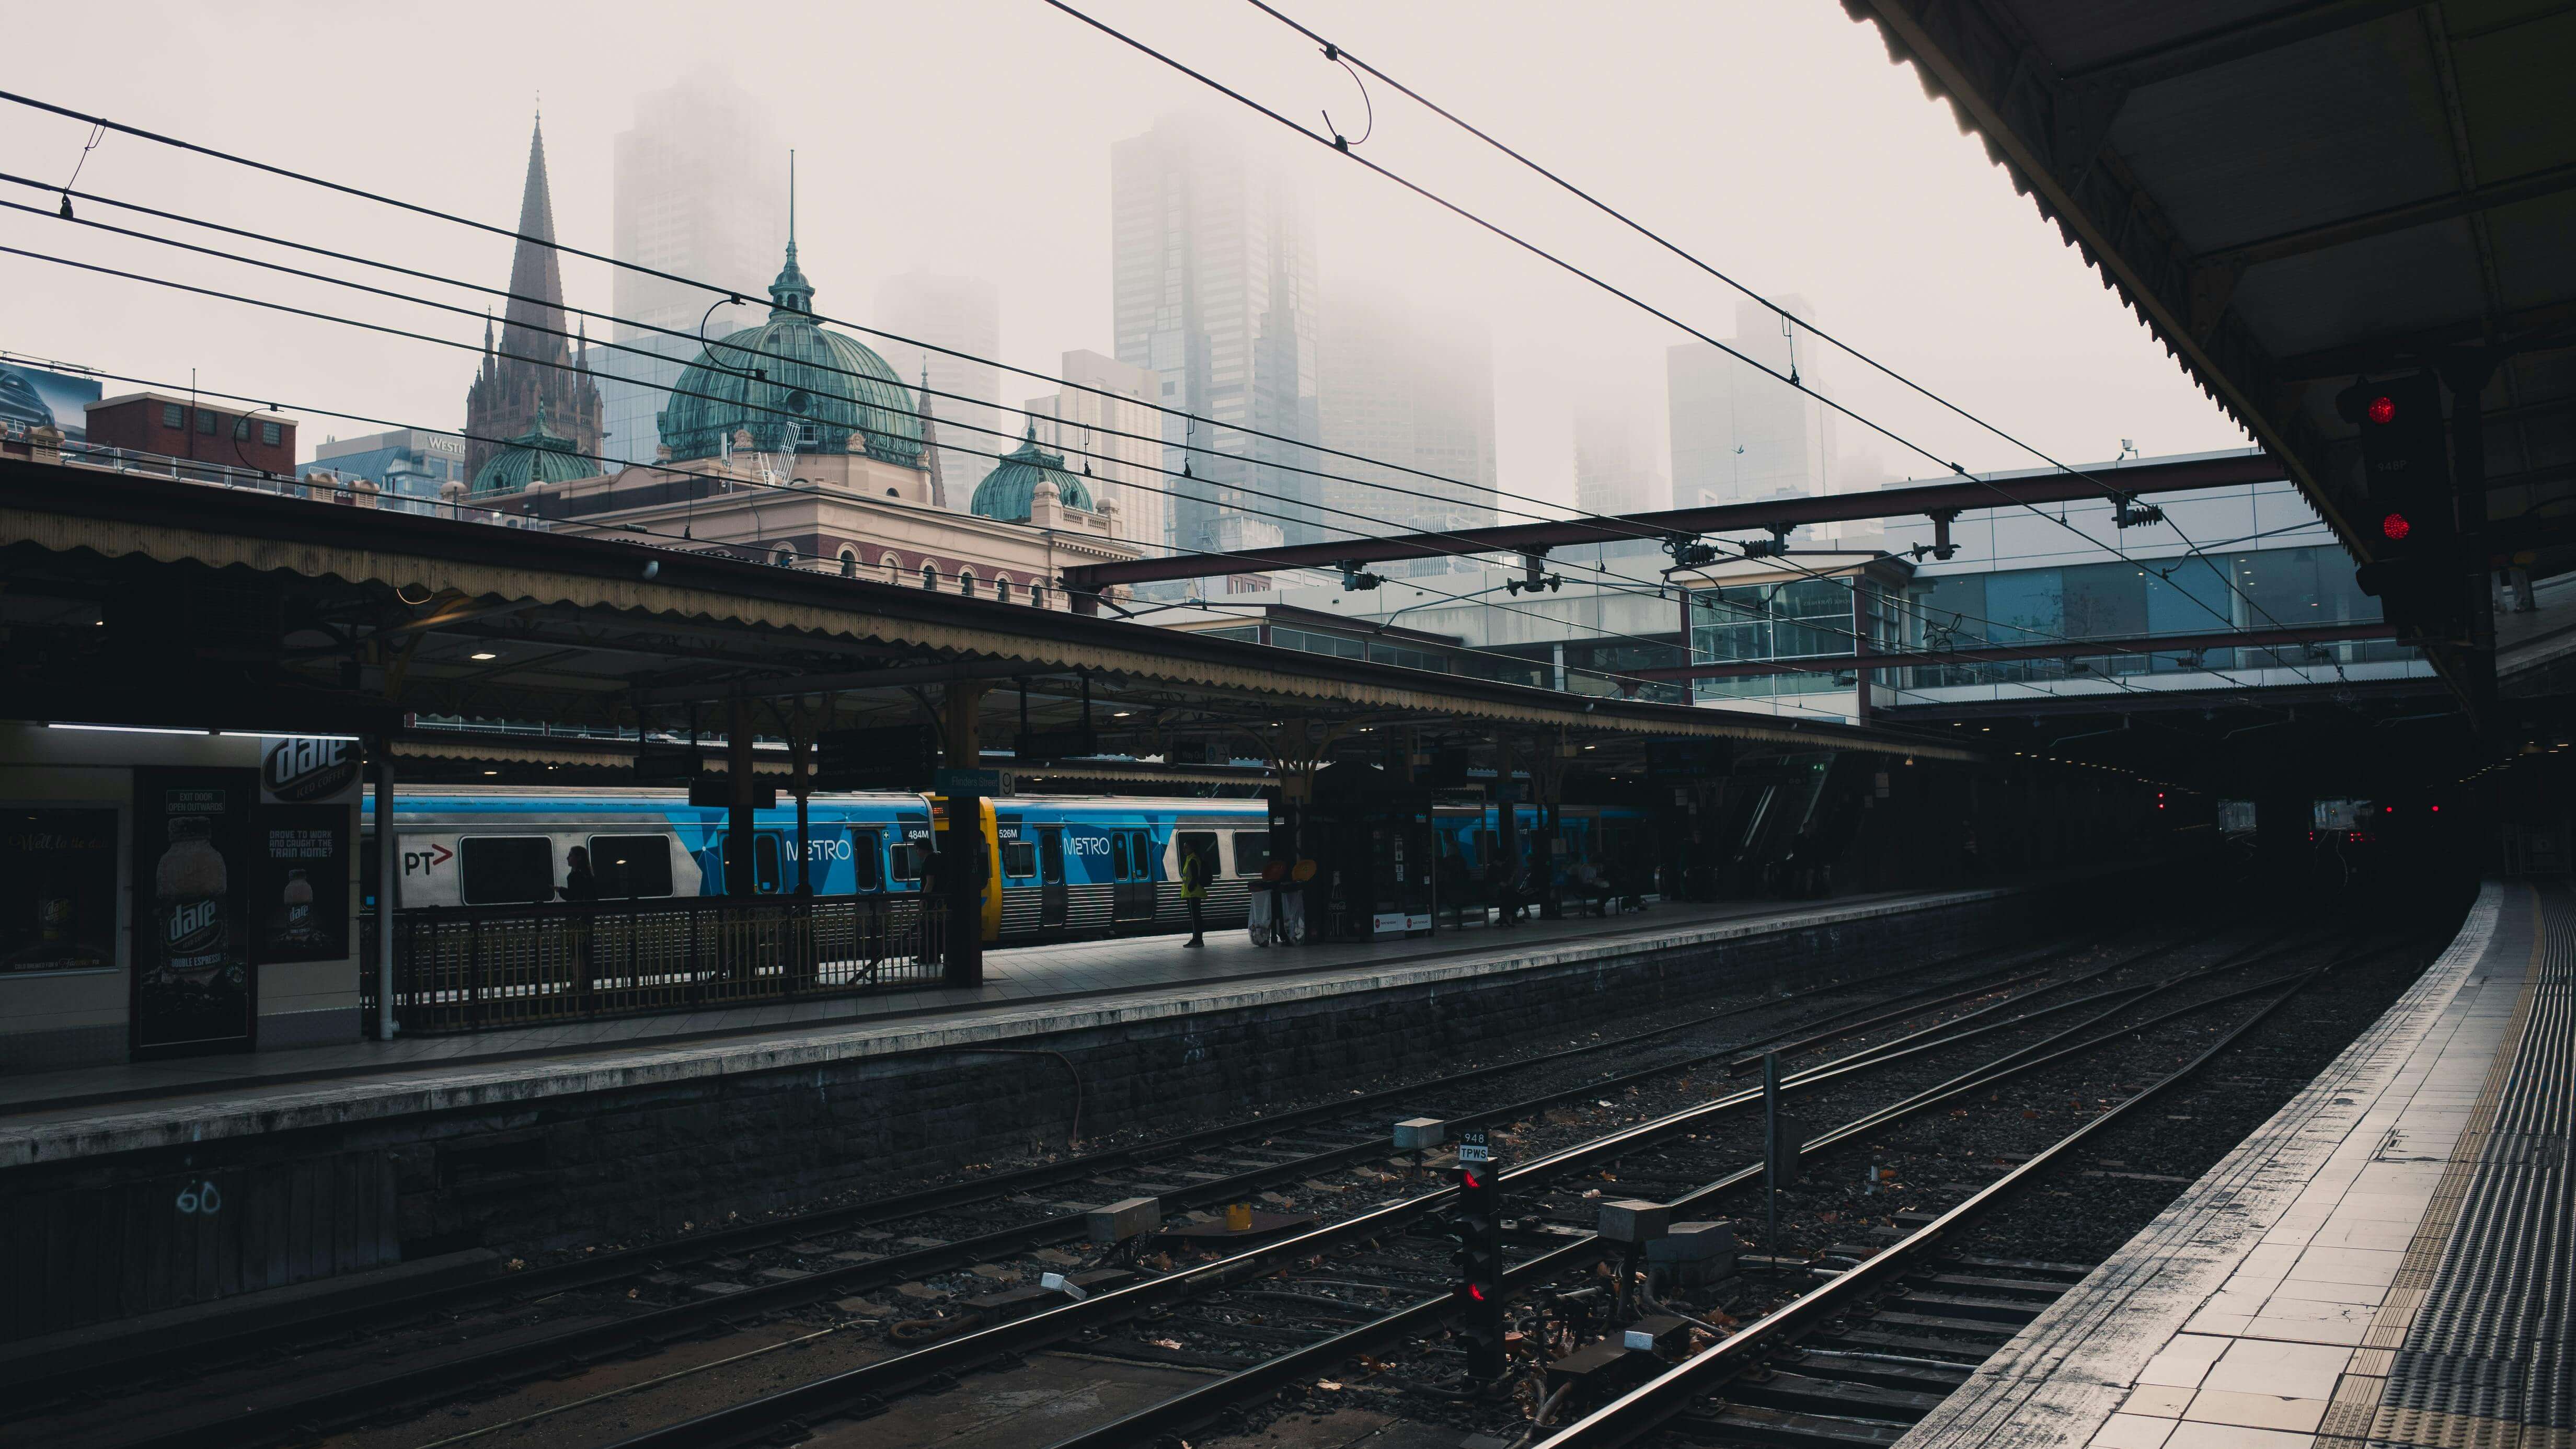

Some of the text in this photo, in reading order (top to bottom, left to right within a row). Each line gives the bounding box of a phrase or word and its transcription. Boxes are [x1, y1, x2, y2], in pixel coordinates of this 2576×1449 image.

[2378, 460, 2407, 472] 948P
[952, 777, 998, 787] Flinders Street
[1002, 773, 1011, 795] 9
[179, 792, 213, 801] EXIT DOOR
[168, 802, 223, 811] OPEN OUTWARDS
[269, 830, 332, 838] DROVE TO WORK
[908, 830, 929, 839] 484M
[999, 830, 1017, 838] 526M
[1064, 837, 1110, 855] METRO
[270, 847, 333, 857] TRAIN HOME?
[290, 905, 310, 922] dare
[170, 900, 217, 941] dare
[171, 953, 221, 968] DOUBLE ESPRESSO
[1465, 1133, 1484, 1143] 948
[1462, 1148, 1486, 1158] TPWS
[177, 1180, 221, 1214] 60
